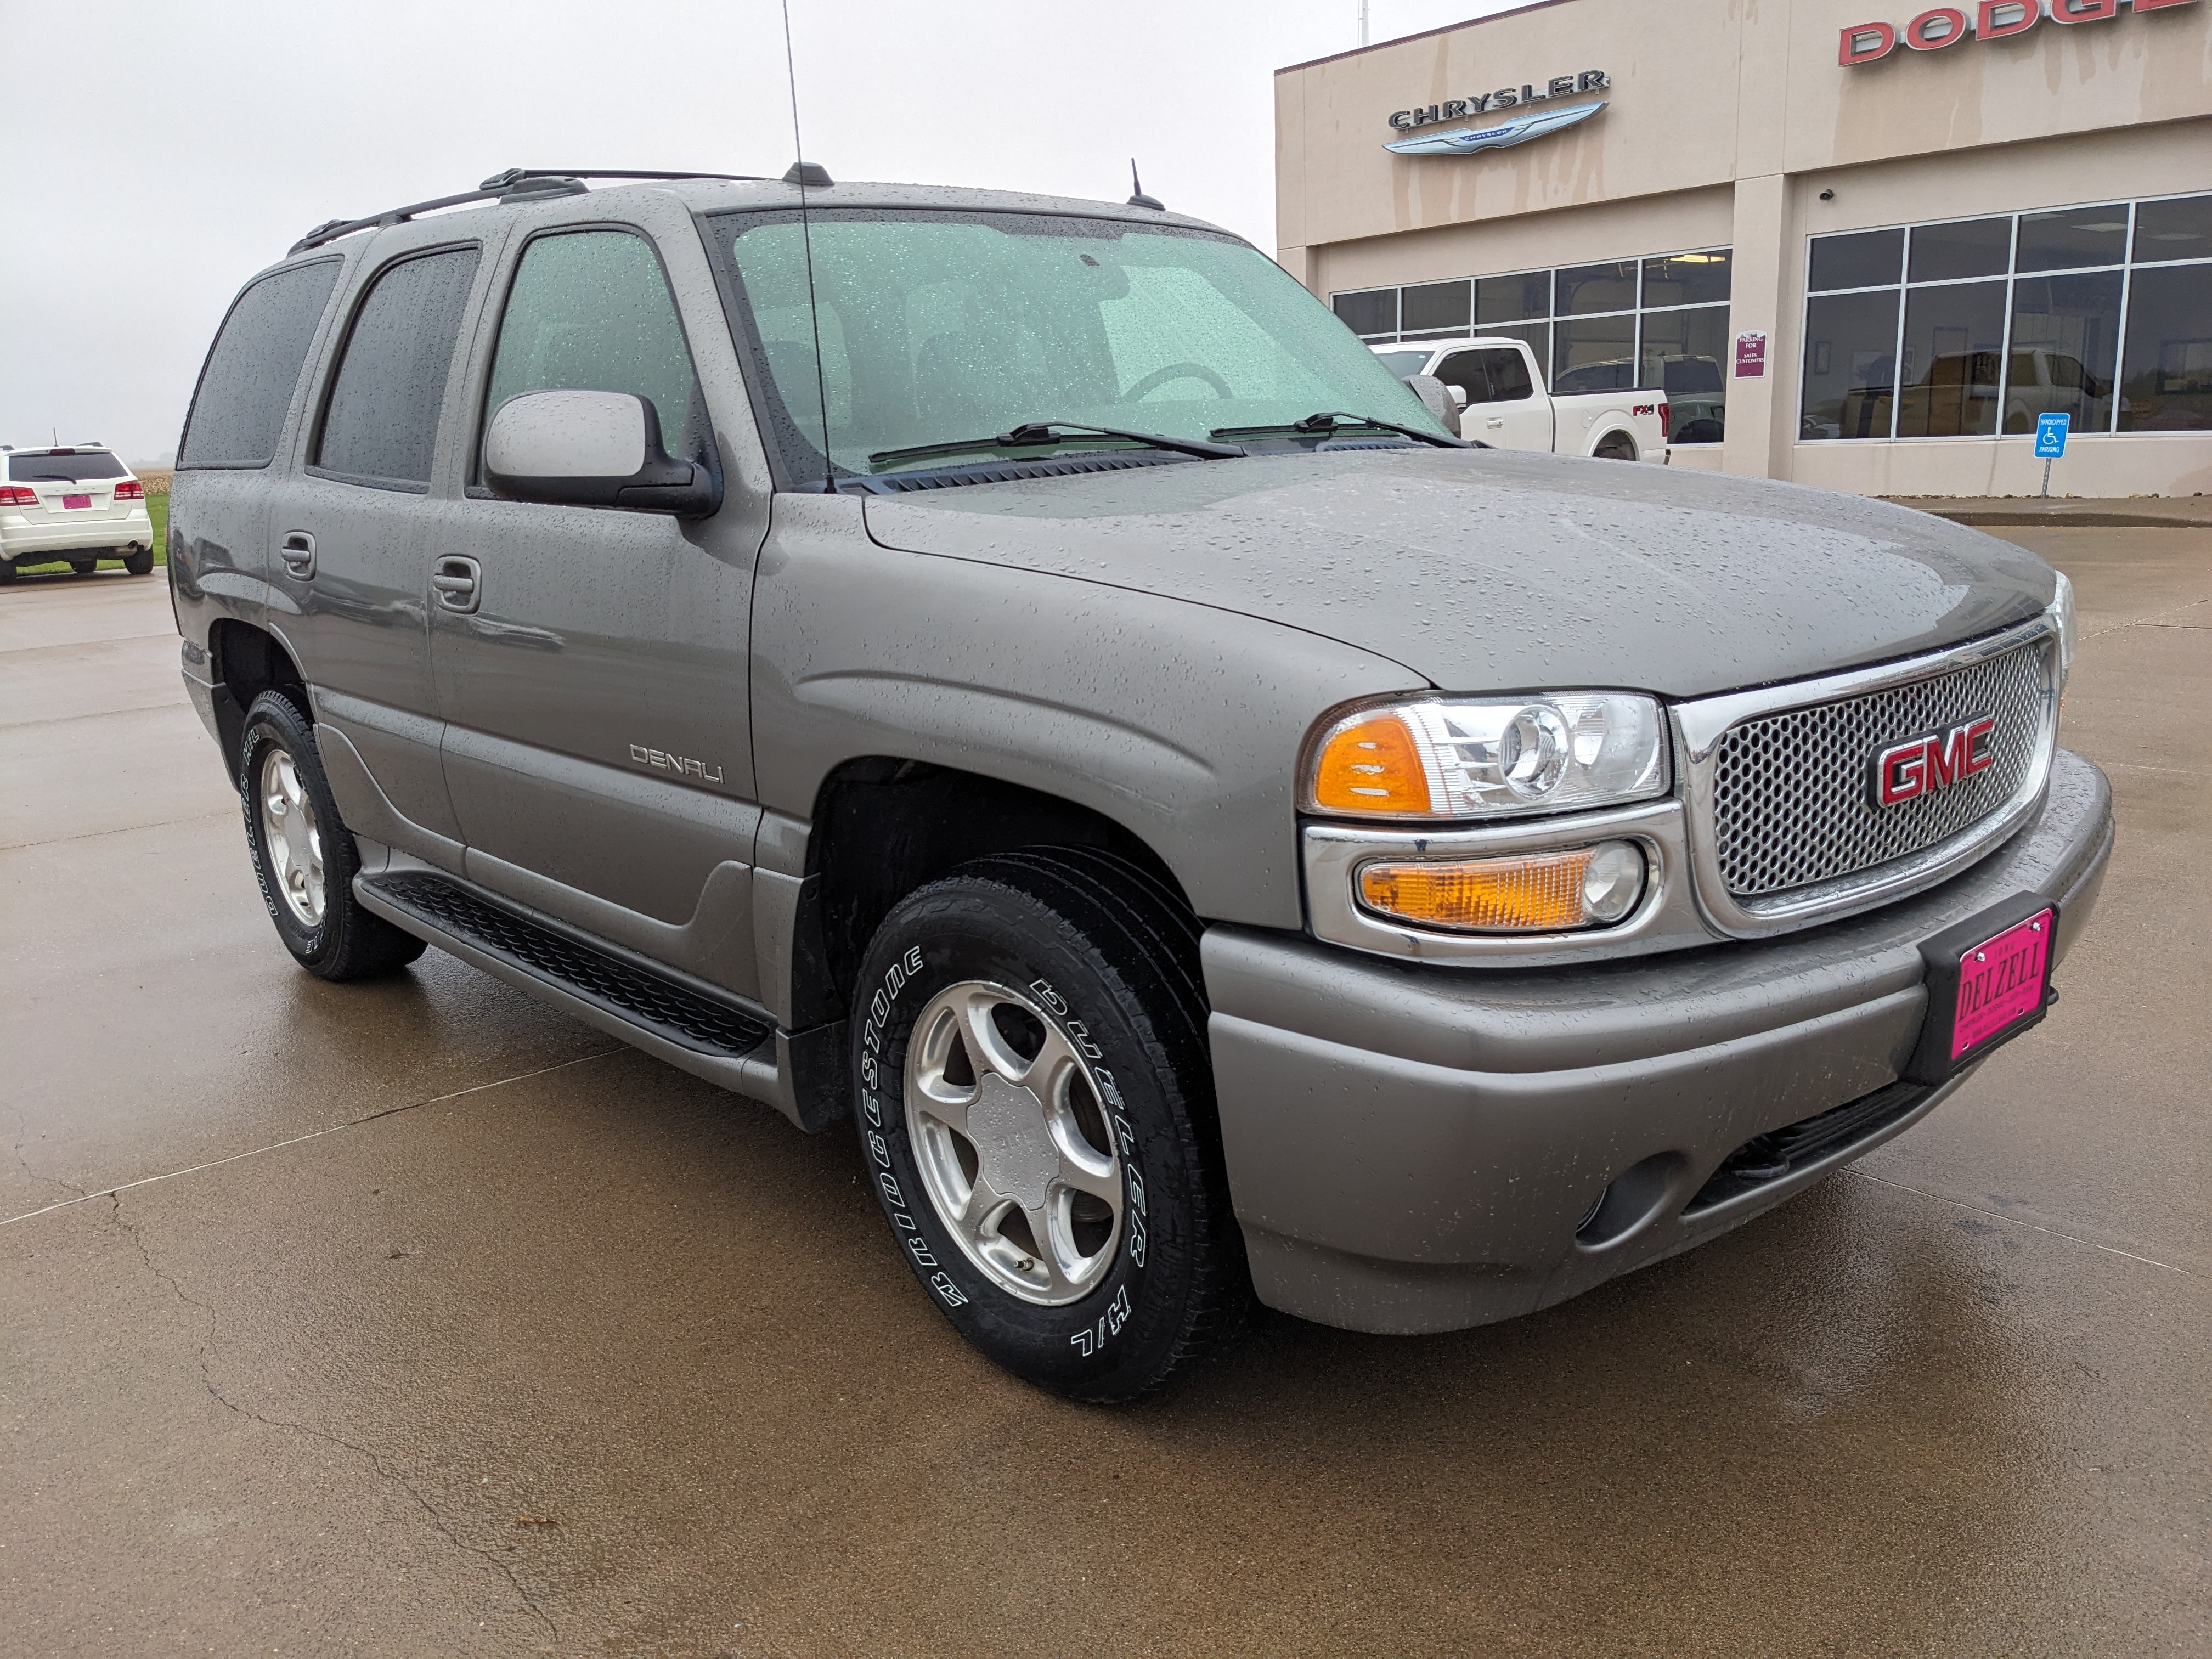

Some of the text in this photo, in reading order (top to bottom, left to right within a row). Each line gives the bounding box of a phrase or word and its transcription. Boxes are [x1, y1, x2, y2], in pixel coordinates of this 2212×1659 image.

[1838, 0, 2200, 67] DODG
[1388, 70, 1606, 129] CHRYSLER
[1464, 129, 1508, 140] CHRYSLER
[1633, 404, 1654, 416] FX4
[630, 744, 724, 784] DENALI
[1877, 714, 1993, 808] GMC
[241, 729, 278, 916] DUELER H/L
[1957, 941, 2040, 1022] DELZELL
[862, 945, 970, 1307] BRIDGESTONE
[1029, 978, 1147, 1357] DUELER H/L
